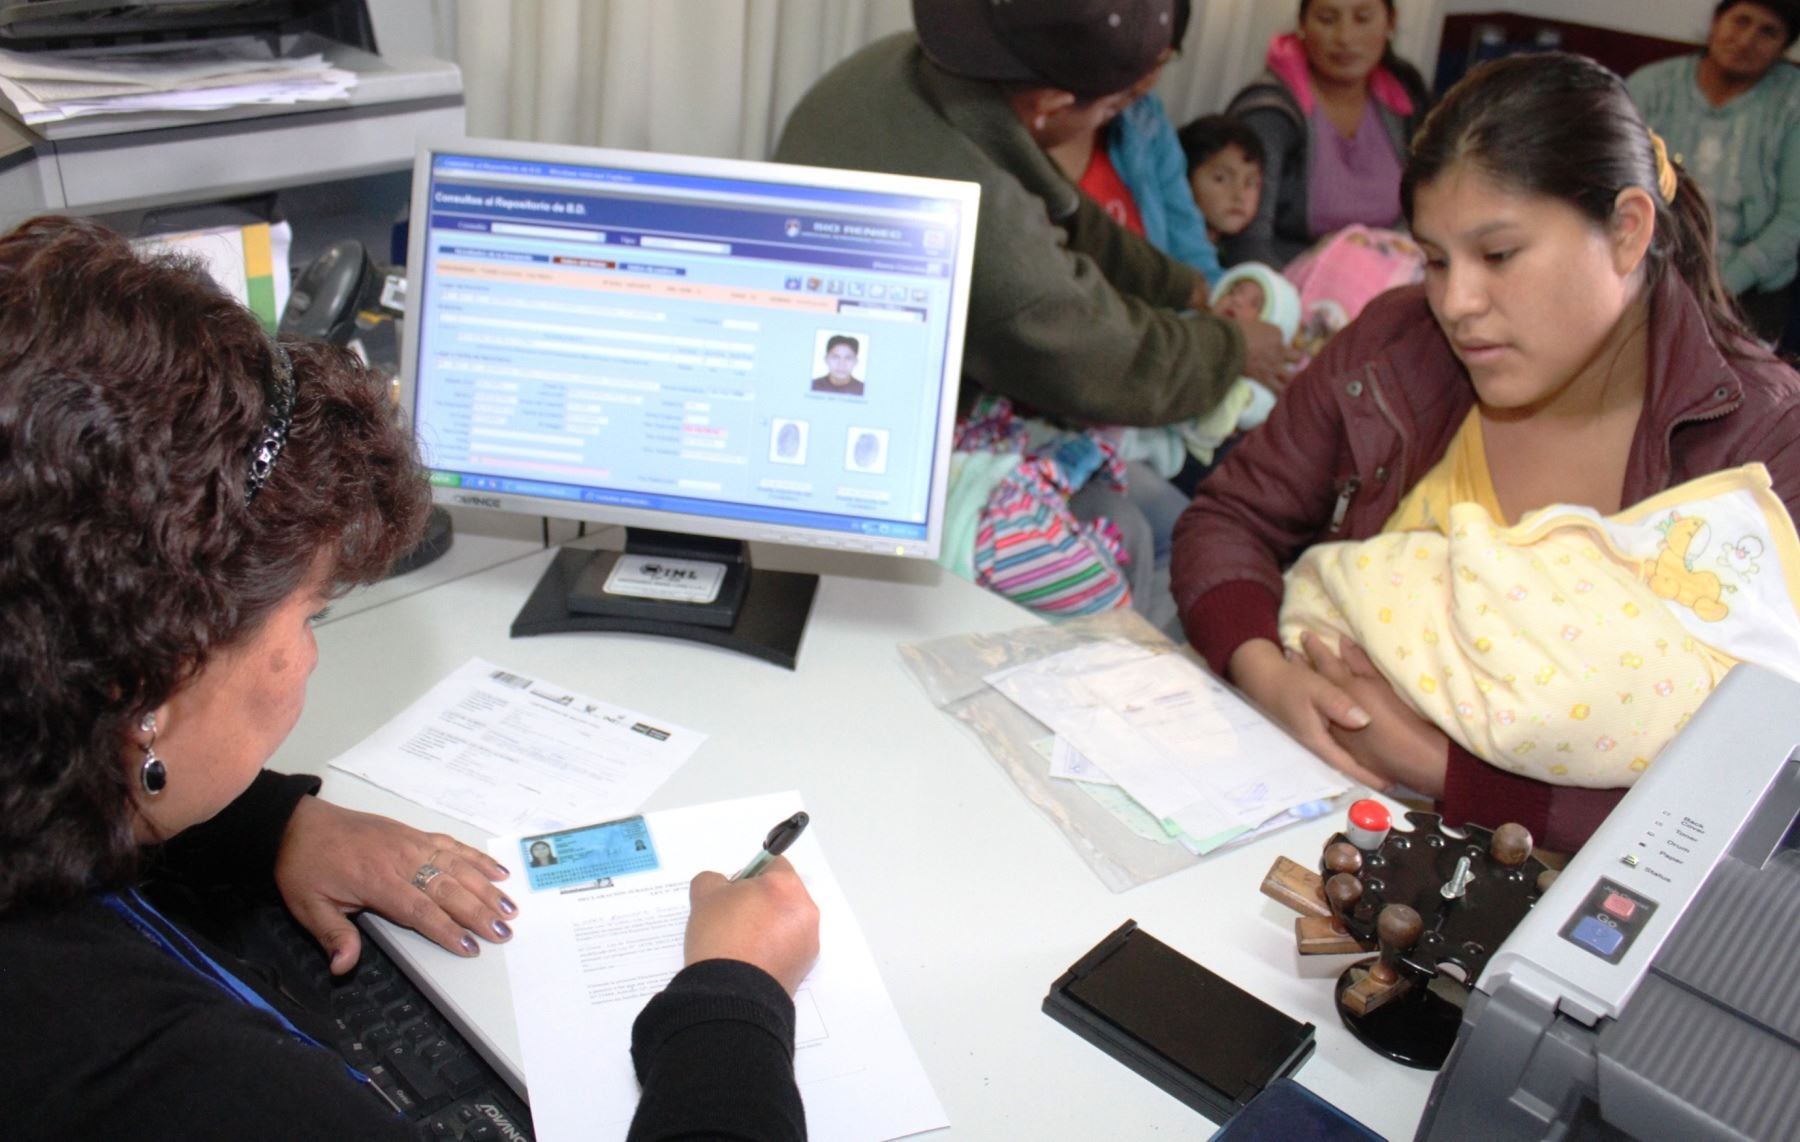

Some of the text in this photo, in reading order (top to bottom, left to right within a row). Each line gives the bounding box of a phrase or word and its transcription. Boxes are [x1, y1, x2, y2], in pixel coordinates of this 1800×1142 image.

[434, 191, 483, 206] Consultas
[495, 196, 551, 211] Repositorio
[551, 202, 565, 214] de
[1681, 821, 1705, 834] Cover
[1683, 816, 1704, 829] Back
[1676, 829, 1698, 842] Toner
[1667, 840, 1690, 853] Drum
[1659, 851, 1684, 864] Paper
[1645, 867, 1671, 883] Status
[1597, 913, 1617, 928] Go
